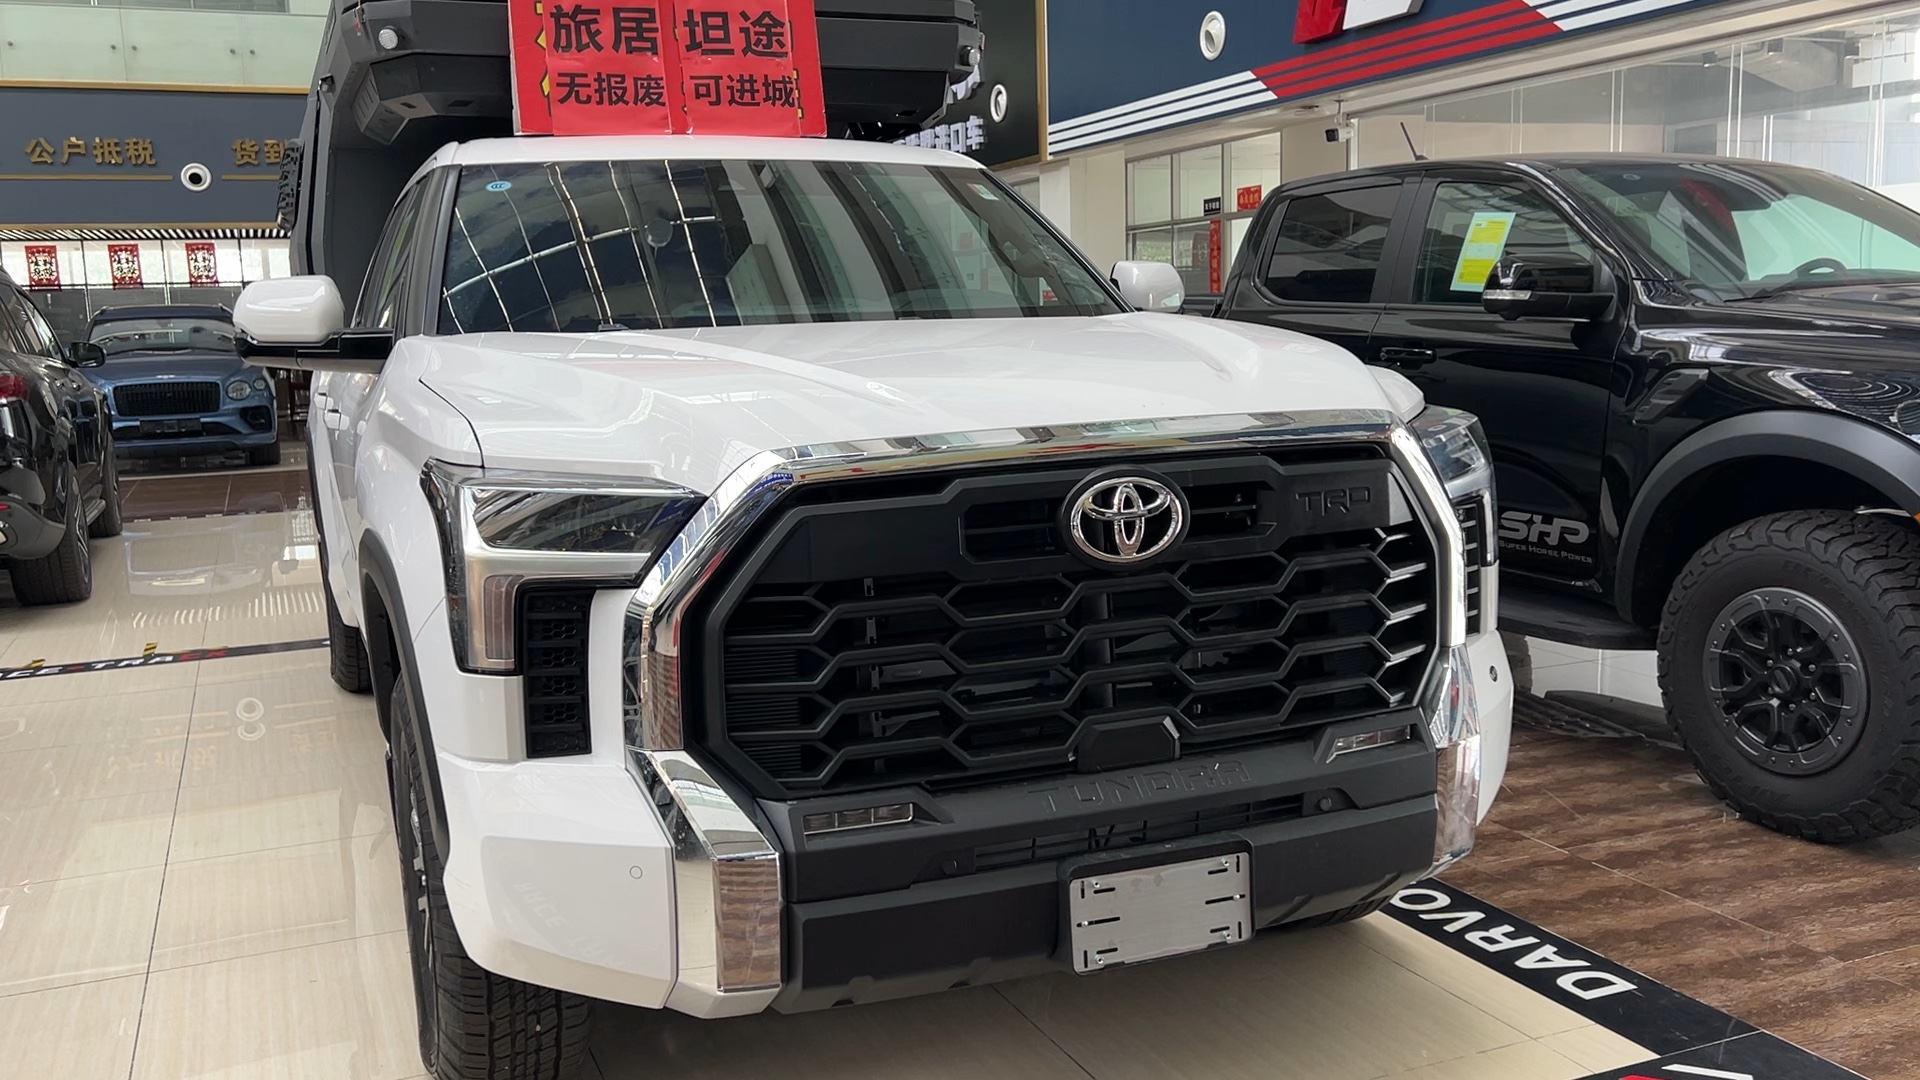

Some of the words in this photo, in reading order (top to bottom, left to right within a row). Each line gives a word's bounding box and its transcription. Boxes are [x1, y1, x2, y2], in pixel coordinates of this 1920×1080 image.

[549, 4, 660, 55] 旅居
[683, 9, 789, 58] 坦途
[556, 72, 666, 107] 无报废
[689, 74, 799, 108] 可进城
[25, 136, 157, 165] 公户抵税
[1295, 486, 1371, 517] TRD
[1498, 510, 1590, 546] SHP
[1560, 551, 1592, 563] POWER
[1026, 758, 1252, 813] TUNDRA
